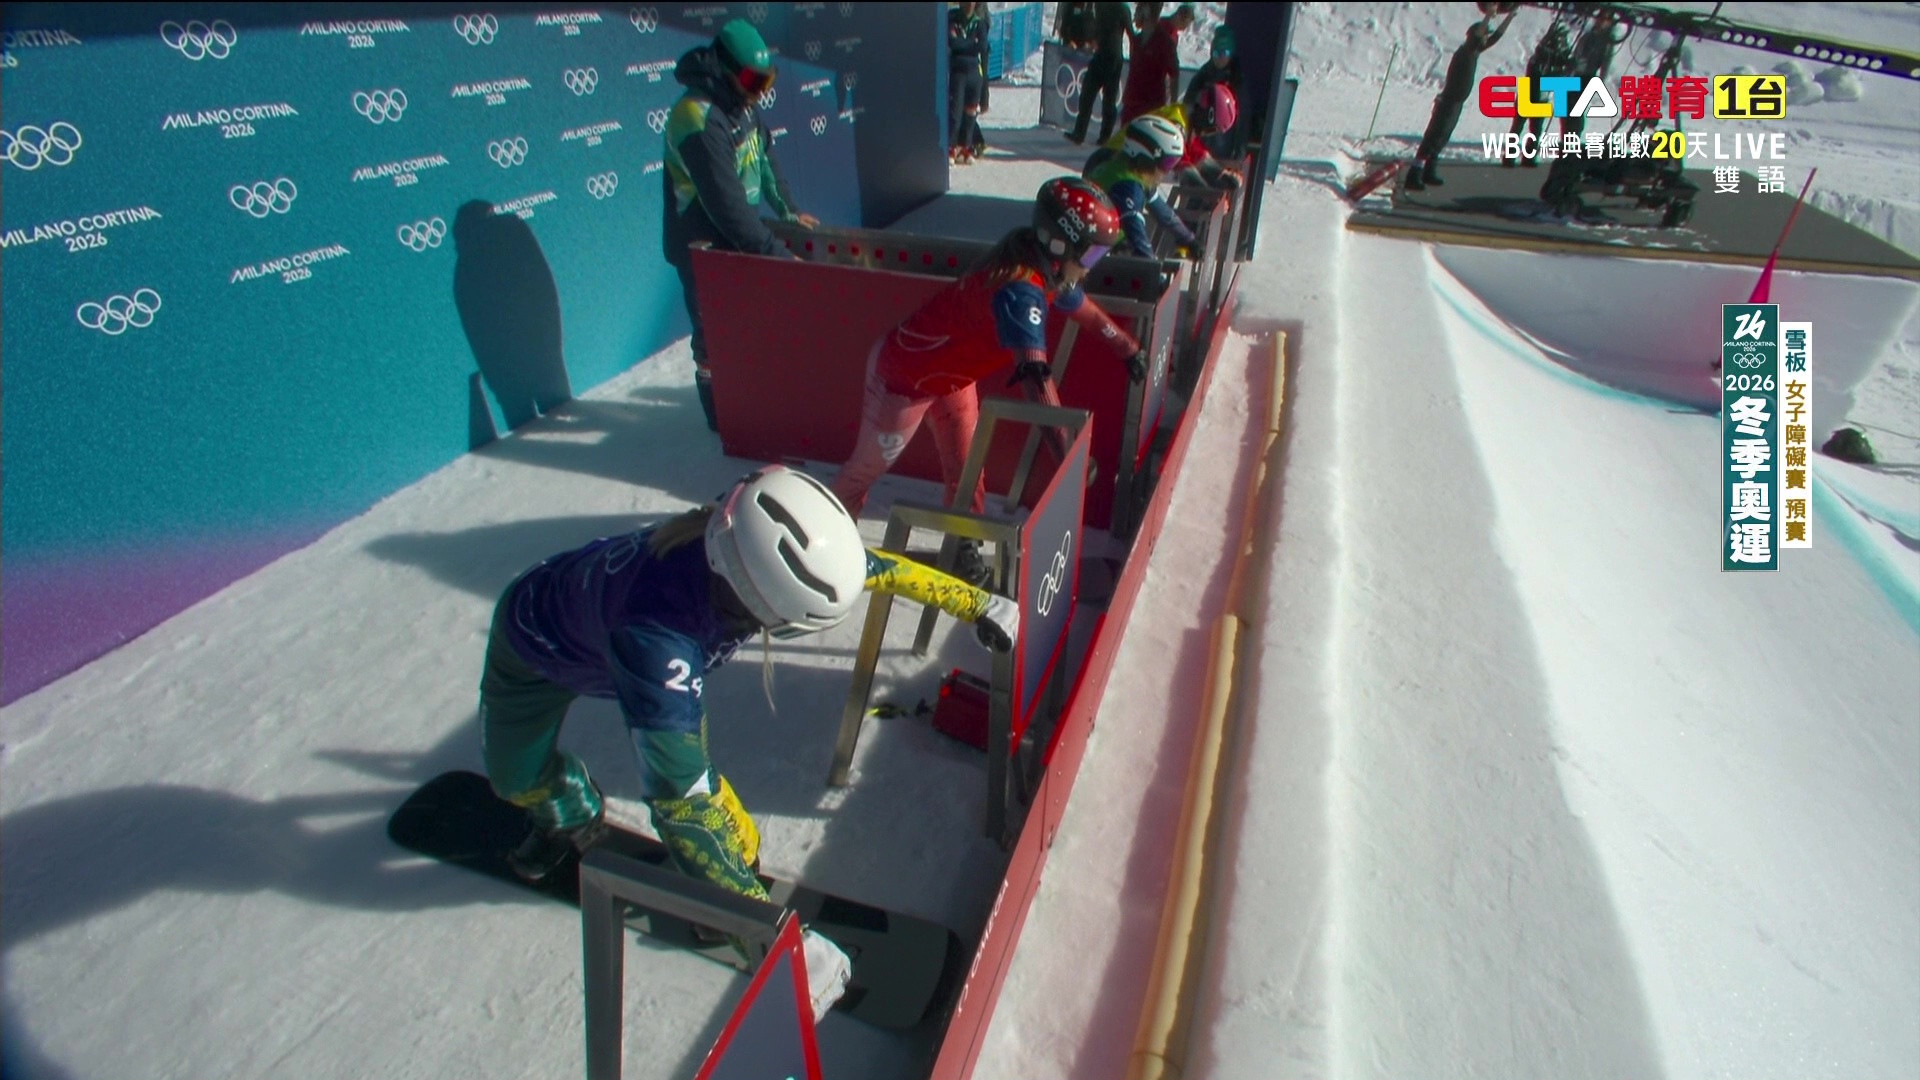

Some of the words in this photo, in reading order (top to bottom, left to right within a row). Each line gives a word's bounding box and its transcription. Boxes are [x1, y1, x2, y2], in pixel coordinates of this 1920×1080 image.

[301, 20, 356, 35] MILANO
[357, 18, 410, 33] CORTINA
[2, 29, 82, 48] ORTINA
[348, 35, 375, 48] 2026
[451, 81, 493, 98] MILANO
[493, 77, 532, 93] CORTINA
[162, 108, 231, 131] MILANO
[232, 102, 299, 122] CORTINA
[222, 122, 255, 139] 2026
[353, 162, 402, 183] MILANO
[402, 153, 450, 173] CORTINA
[394, 172, 418, 187] 2026
[78, 206, 163, 232] CORTINA
[65, 232, 108, 253] 2026
[231, 257, 292, 284] MILANO
[292, 243, 351, 268] CORTINA
[283, 267, 312, 285] 2026
